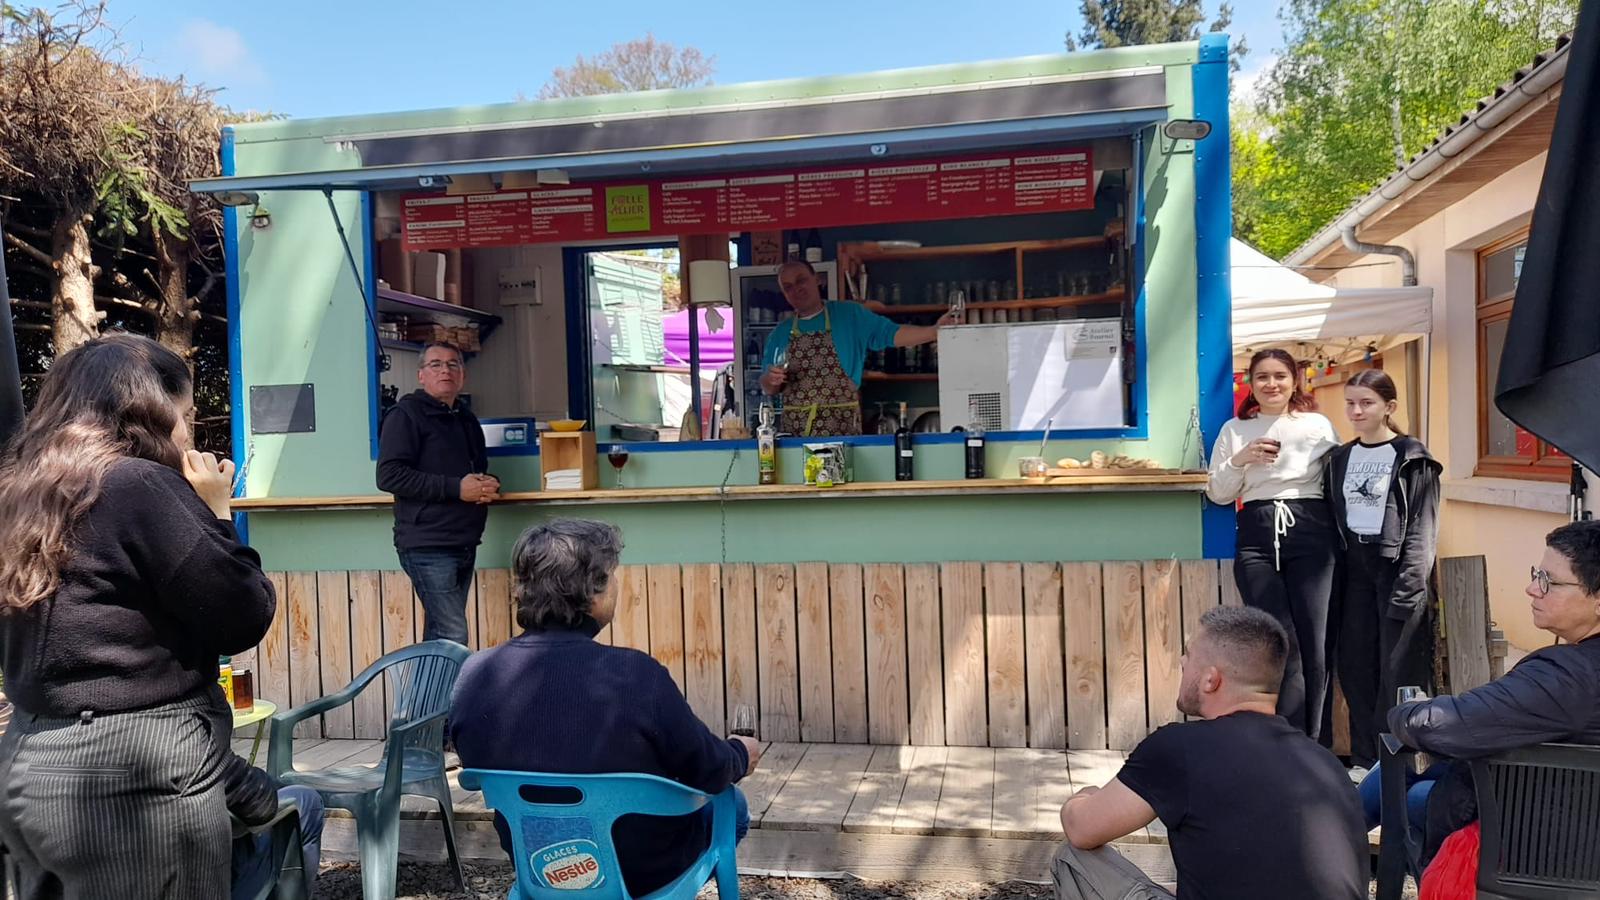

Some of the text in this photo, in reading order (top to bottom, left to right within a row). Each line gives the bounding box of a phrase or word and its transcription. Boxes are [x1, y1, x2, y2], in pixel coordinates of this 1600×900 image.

[1347, 462, 1392, 474] AMONES
[543, 845, 578, 862] GLACES
[545, 856, 598, 885] Nestlé
